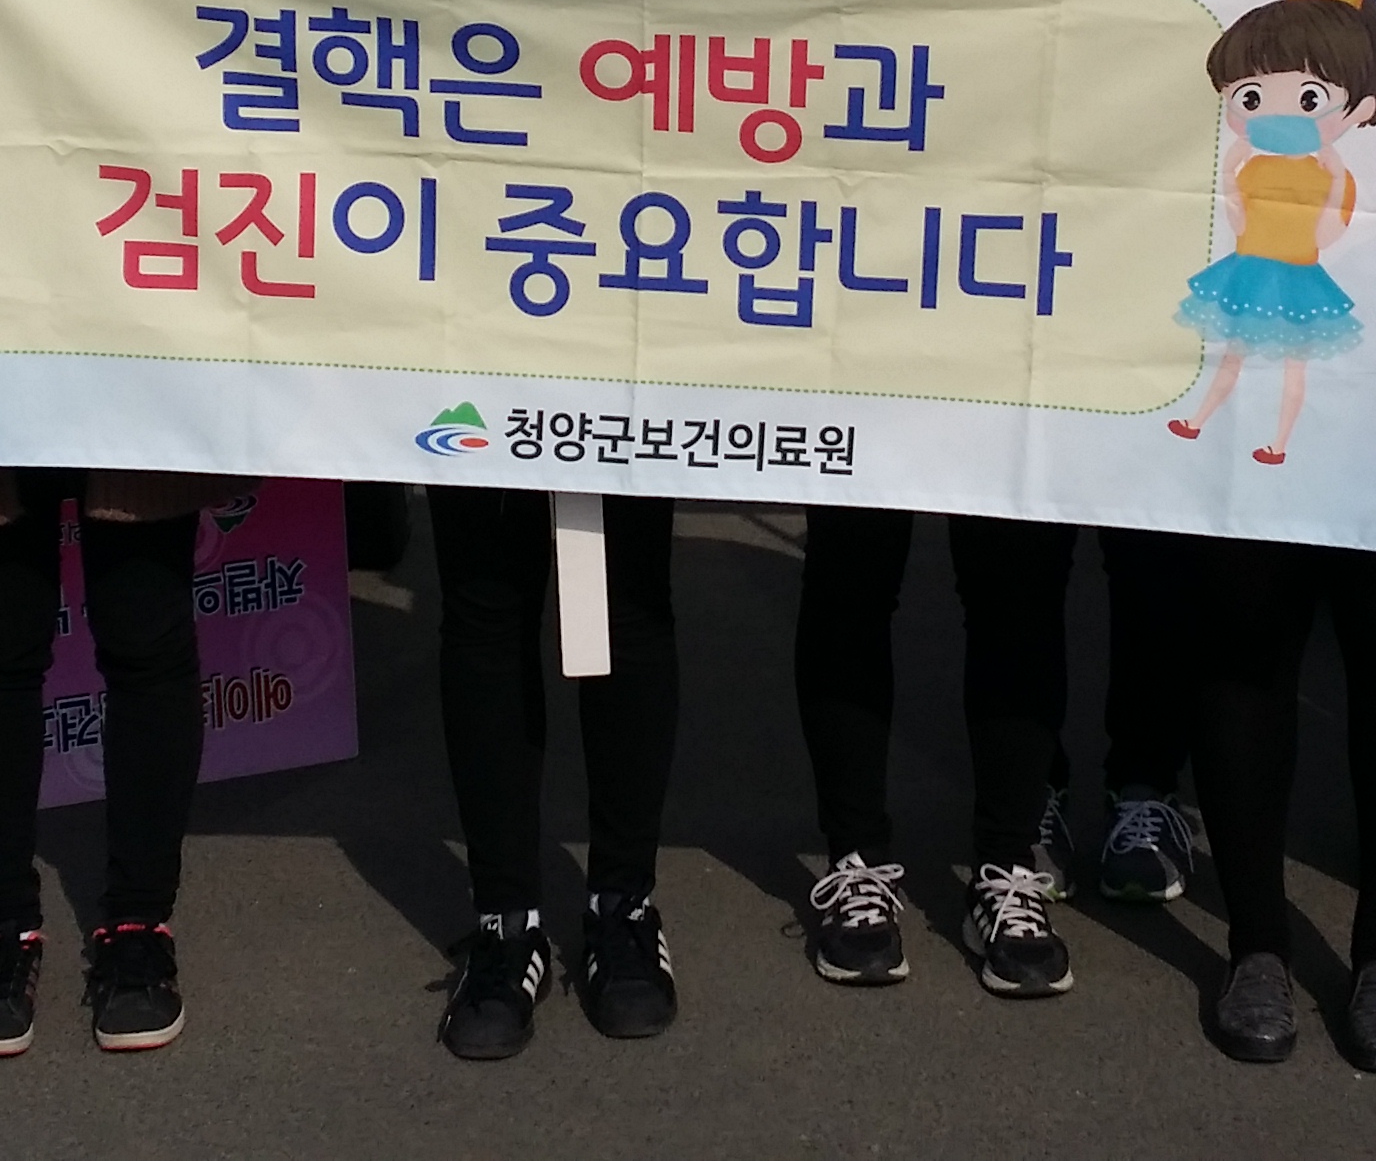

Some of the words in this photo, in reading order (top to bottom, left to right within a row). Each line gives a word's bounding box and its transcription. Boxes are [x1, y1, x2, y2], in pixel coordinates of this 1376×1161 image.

[194, 4, 544, 147] 결핵은
[578, 32, 945, 165] 예방과
[94, 162, 438, 300] 검진이
[484, 183, 1073, 328] 중요합니다
[502, 406, 857, 476] 청양군보건의료원
